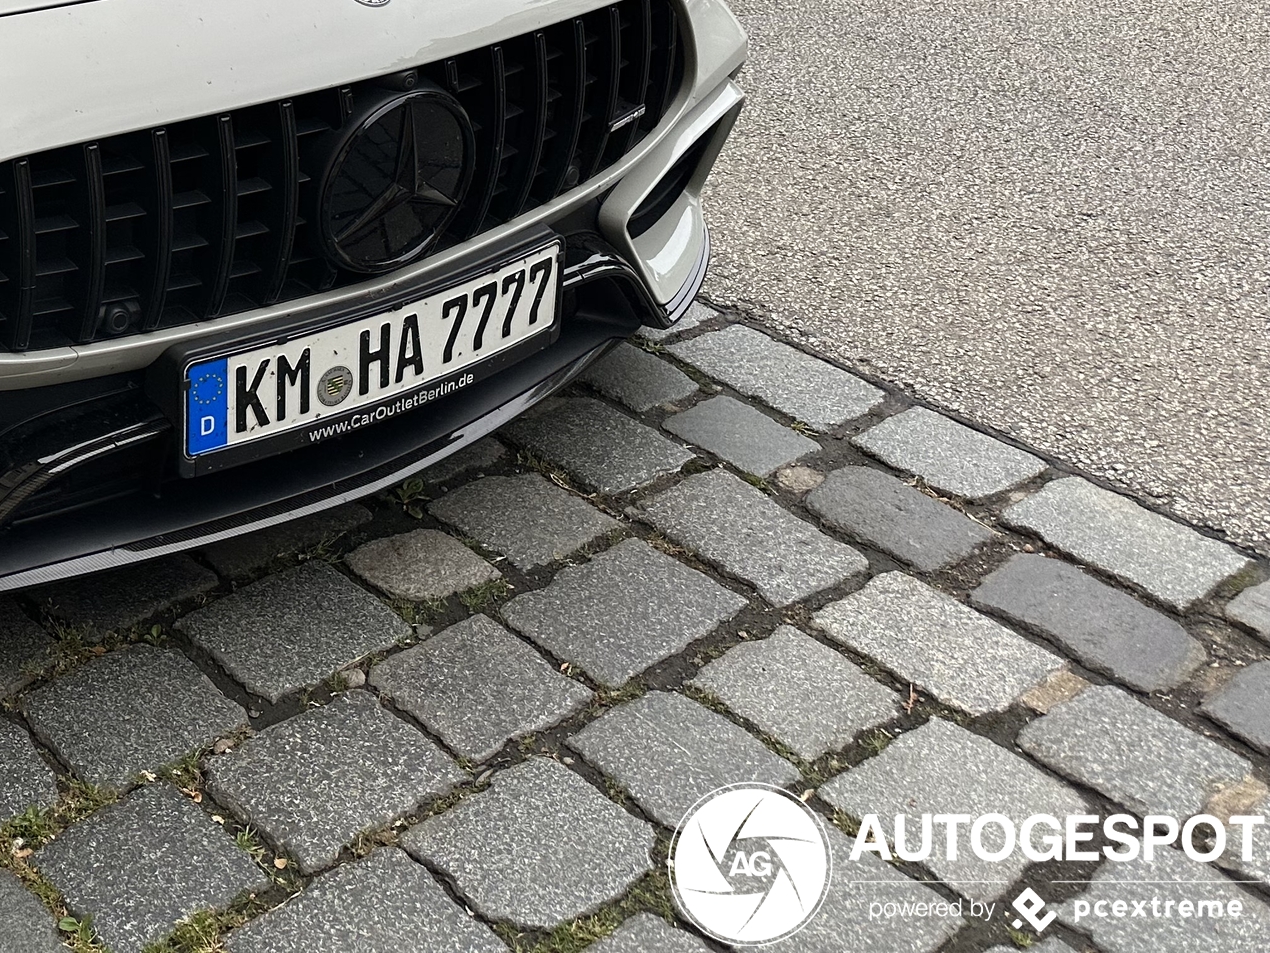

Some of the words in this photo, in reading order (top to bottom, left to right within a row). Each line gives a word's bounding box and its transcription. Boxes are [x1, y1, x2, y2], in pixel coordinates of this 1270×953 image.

[200, 415, 215, 436] D
[235, 348, 311, 433] KM
[358, 313, 424, 396] HA
[441, 256, 553, 364] 7777
[308, 373, 474, 442] www.CarOutletBerlin.de
